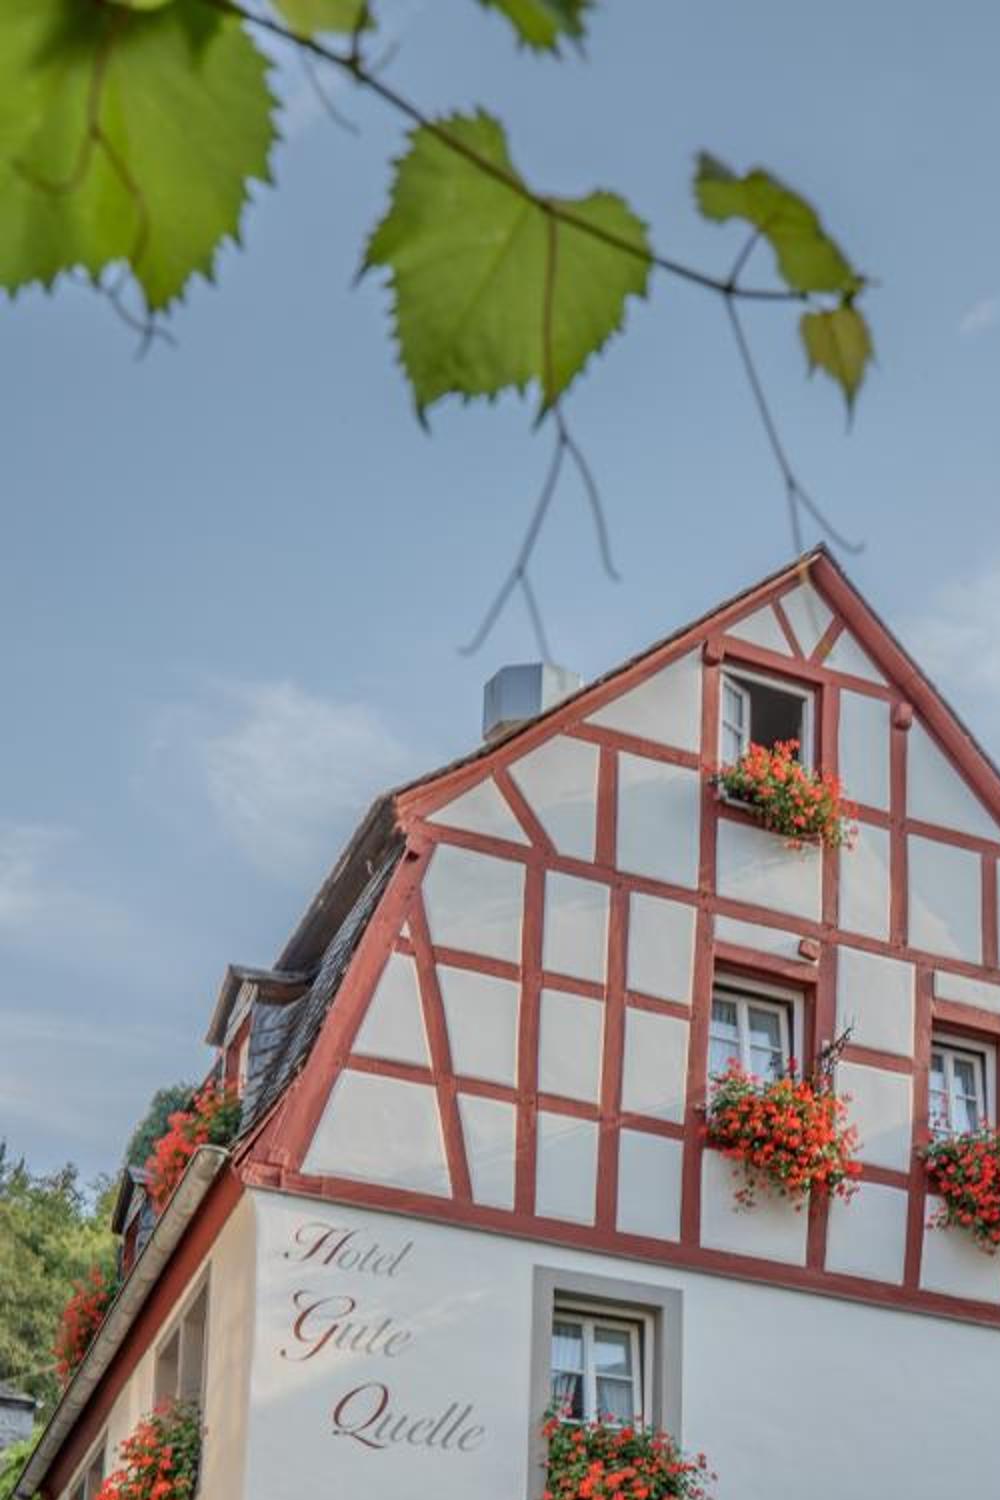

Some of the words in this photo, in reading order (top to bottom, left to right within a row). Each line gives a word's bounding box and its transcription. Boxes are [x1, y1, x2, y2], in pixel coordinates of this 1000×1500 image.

[283, 1221, 414, 1278] Hotel
[280, 1289, 413, 1361] Gute
[332, 1381, 486, 1452] Quelle
